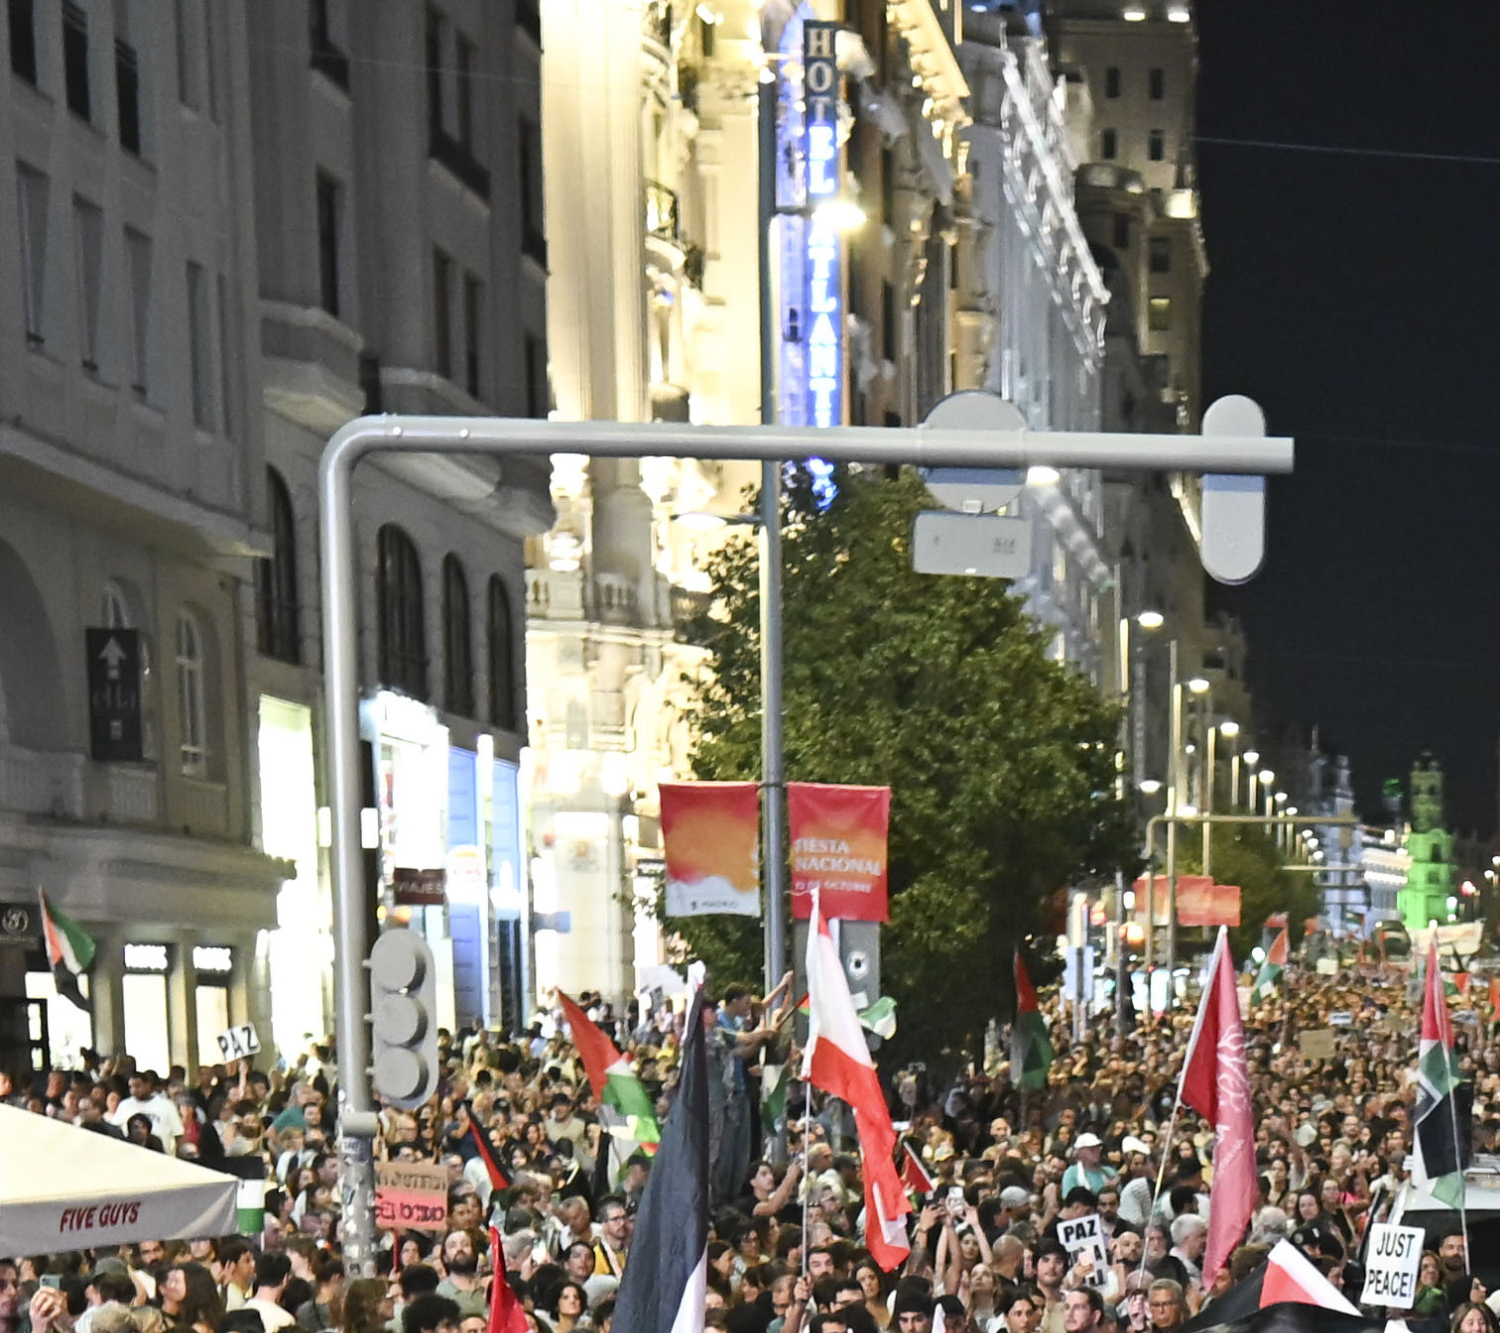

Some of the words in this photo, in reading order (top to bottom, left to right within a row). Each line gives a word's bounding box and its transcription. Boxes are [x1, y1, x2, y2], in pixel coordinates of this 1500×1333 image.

[804, 28, 835, 194] HOTEL
[795, 856, 882, 877] NACIONAL
[217, 1026, 258, 1060] PAZ
[59, 1205, 96, 1234] FIVE
[98, 1201, 141, 1228] GUYS
[1063, 1219, 1098, 1244] PAZ
[1376, 1231, 1416, 1259] JUST
[1366, 1268, 1414, 1299] PEACE!
